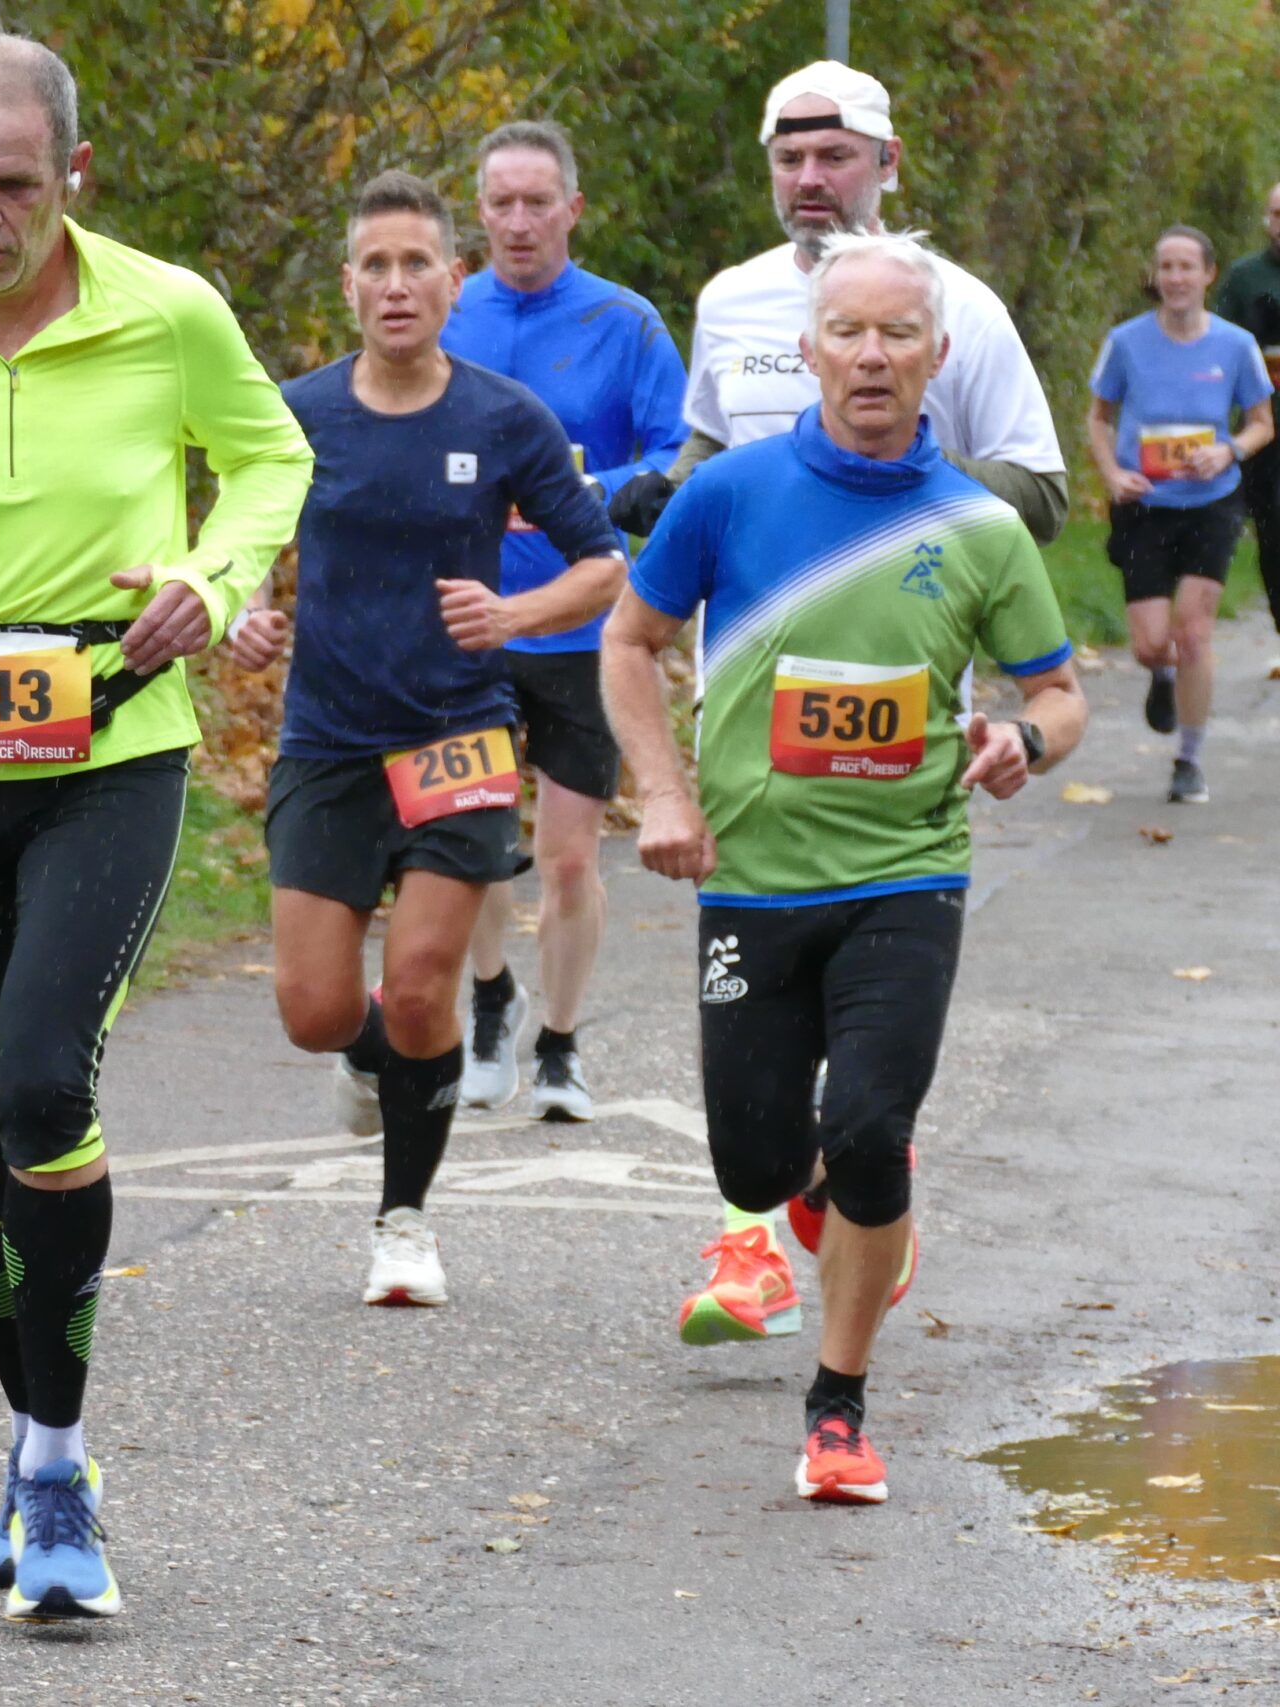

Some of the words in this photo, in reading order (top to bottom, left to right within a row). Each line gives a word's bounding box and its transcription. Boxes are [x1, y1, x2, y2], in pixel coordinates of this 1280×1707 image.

[799, 692, 899, 743] 530
[31, 747, 75, 759] RESULT
[414, 736, 493, 790] 261
[831, 761, 860, 774] RACE
[875, 763, 912, 775] RESULT
[714, 979, 739, 992] LSG
